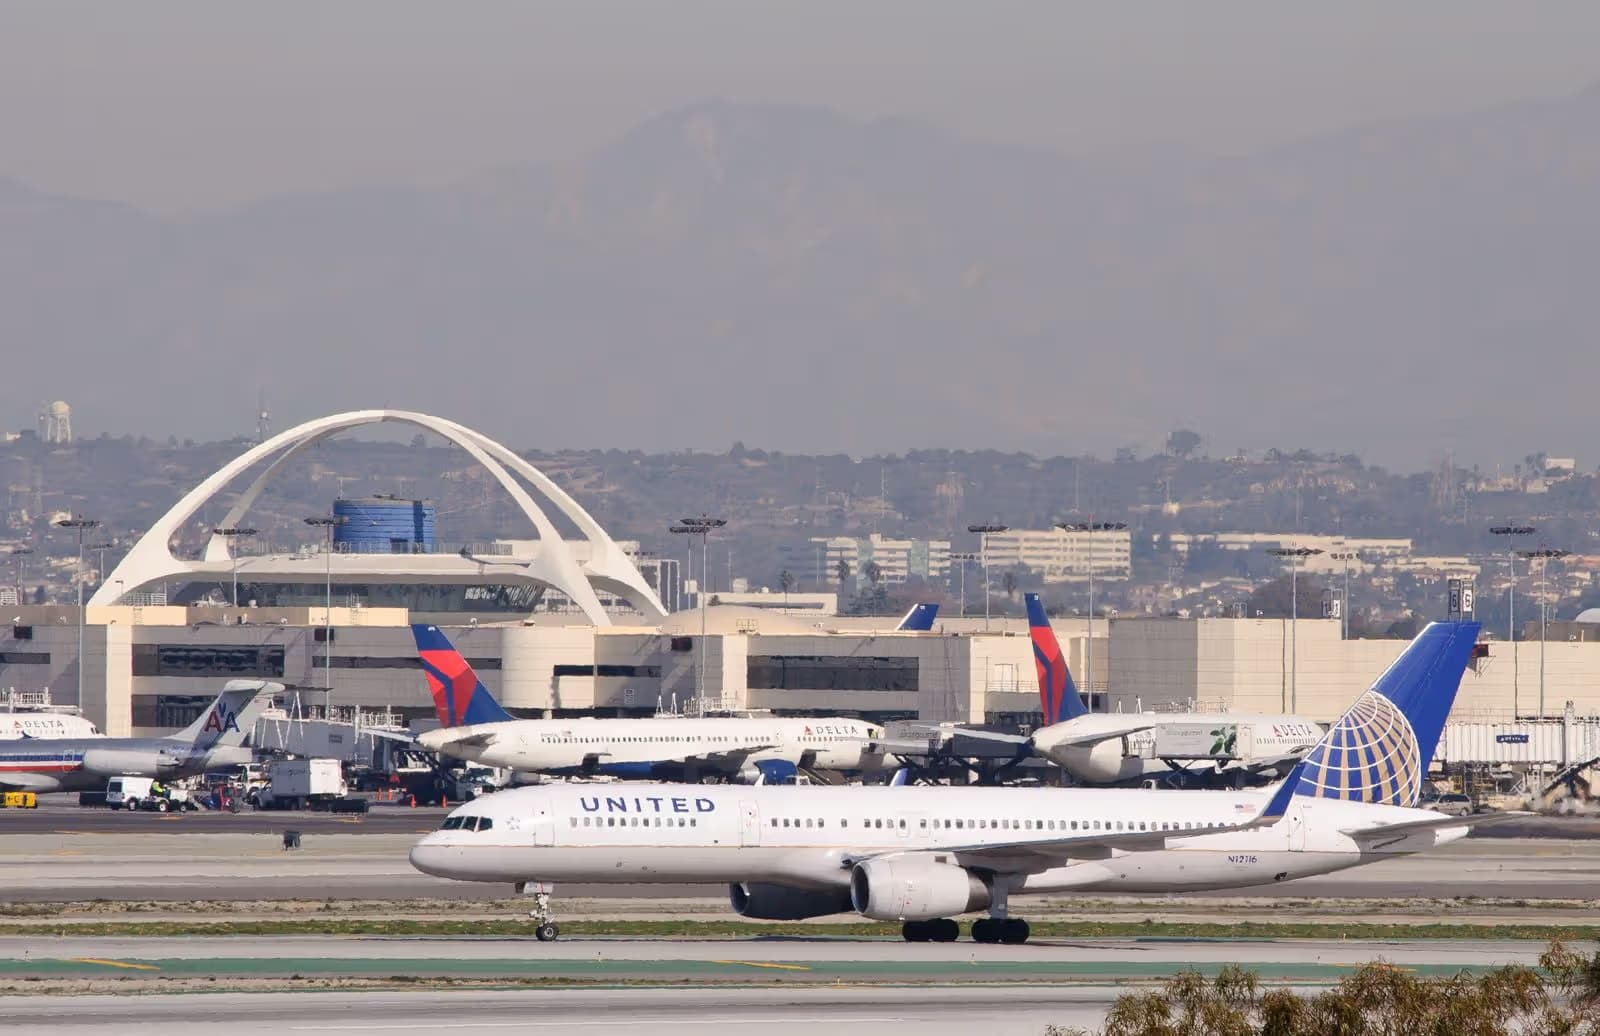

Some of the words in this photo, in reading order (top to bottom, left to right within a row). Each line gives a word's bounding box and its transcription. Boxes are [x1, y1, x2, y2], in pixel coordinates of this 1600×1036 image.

[24, 720, 65, 729] DELTA
[815, 725, 859, 736] DELTA
[1280, 724, 1313, 737] DELTA
[580, 796, 716, 813] UNITED
[1227, 855, 1258, 864] N12116
